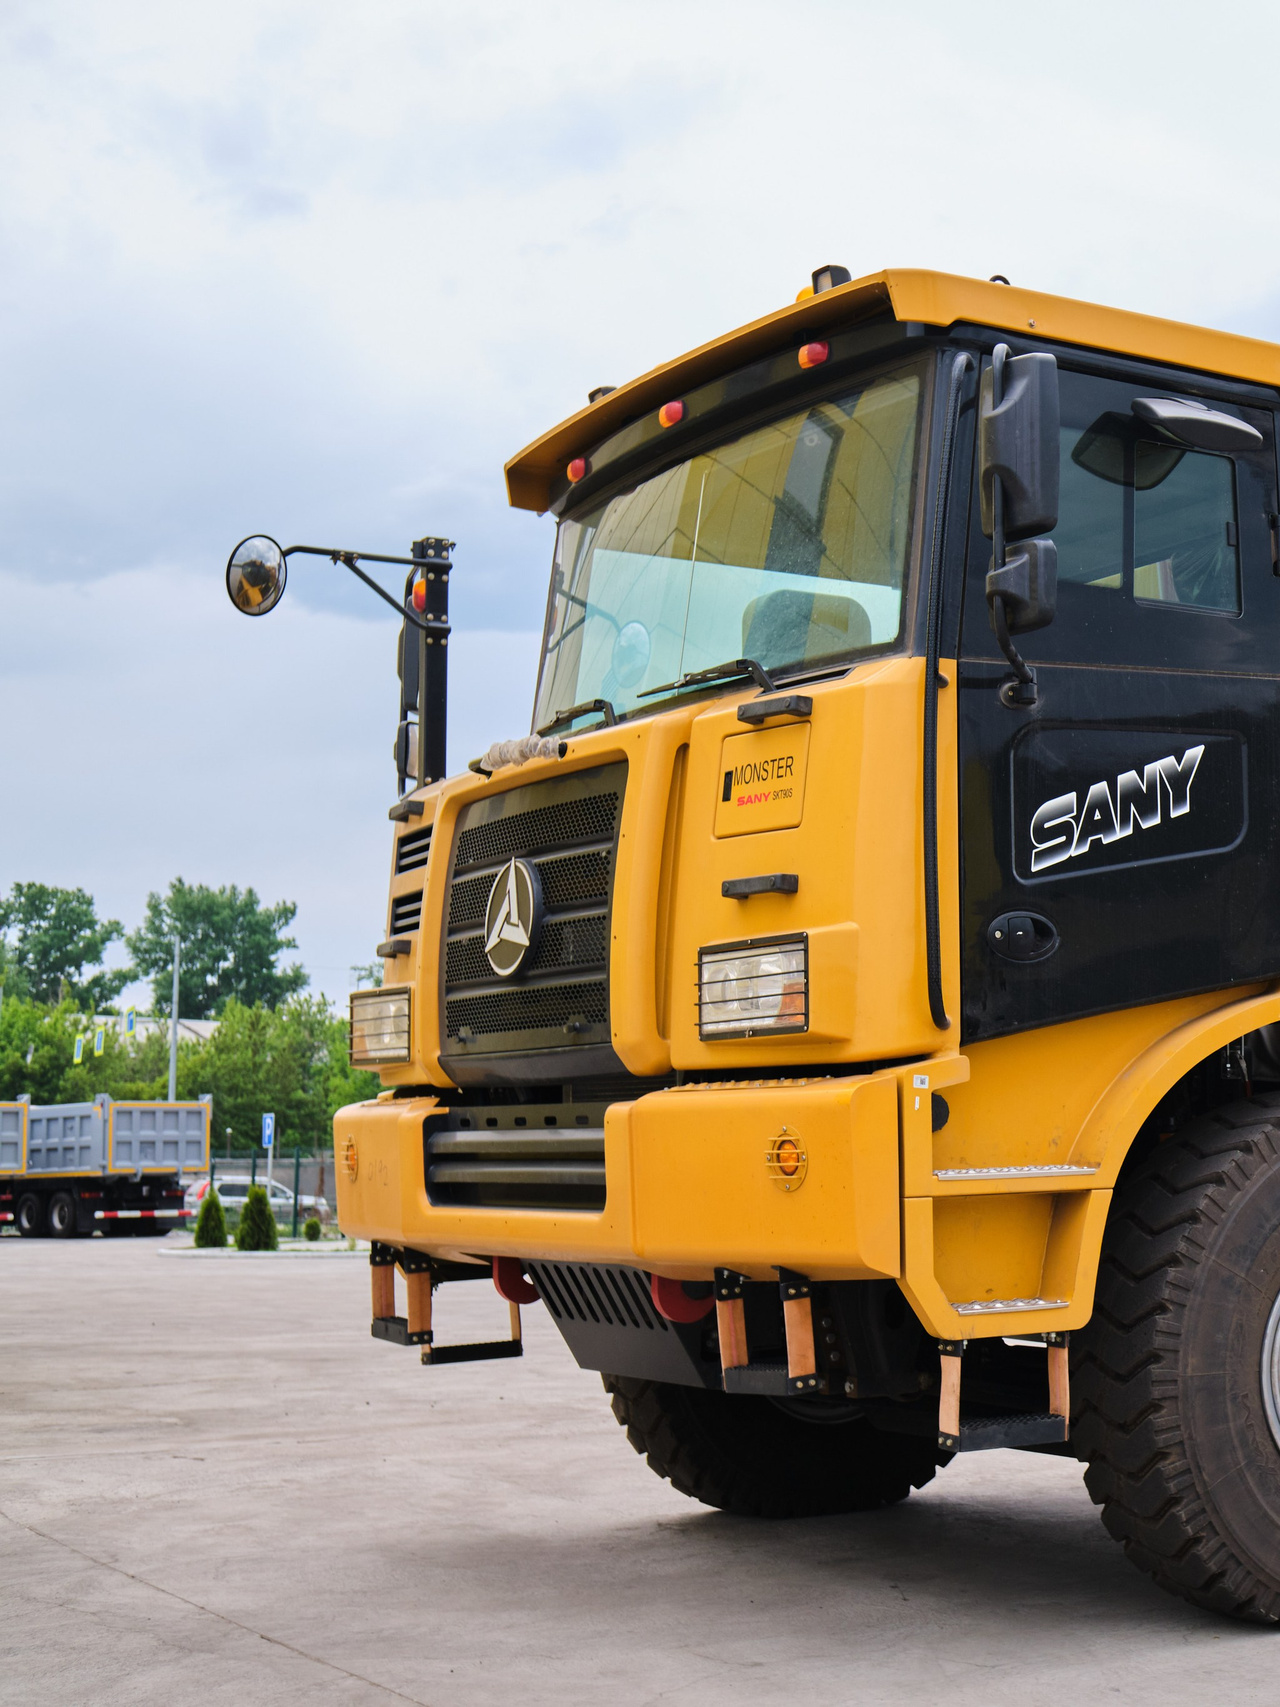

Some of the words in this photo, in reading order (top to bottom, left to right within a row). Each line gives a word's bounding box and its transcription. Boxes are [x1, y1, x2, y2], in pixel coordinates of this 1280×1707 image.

[733, 755, 794, 787] MONSTER
[737, 791, 771, 807] SANY
[772, 787, 793, 801] SKT90S
[1030, 744, 1205, 873] SANY
[265, 1117, 272, 1145] P
